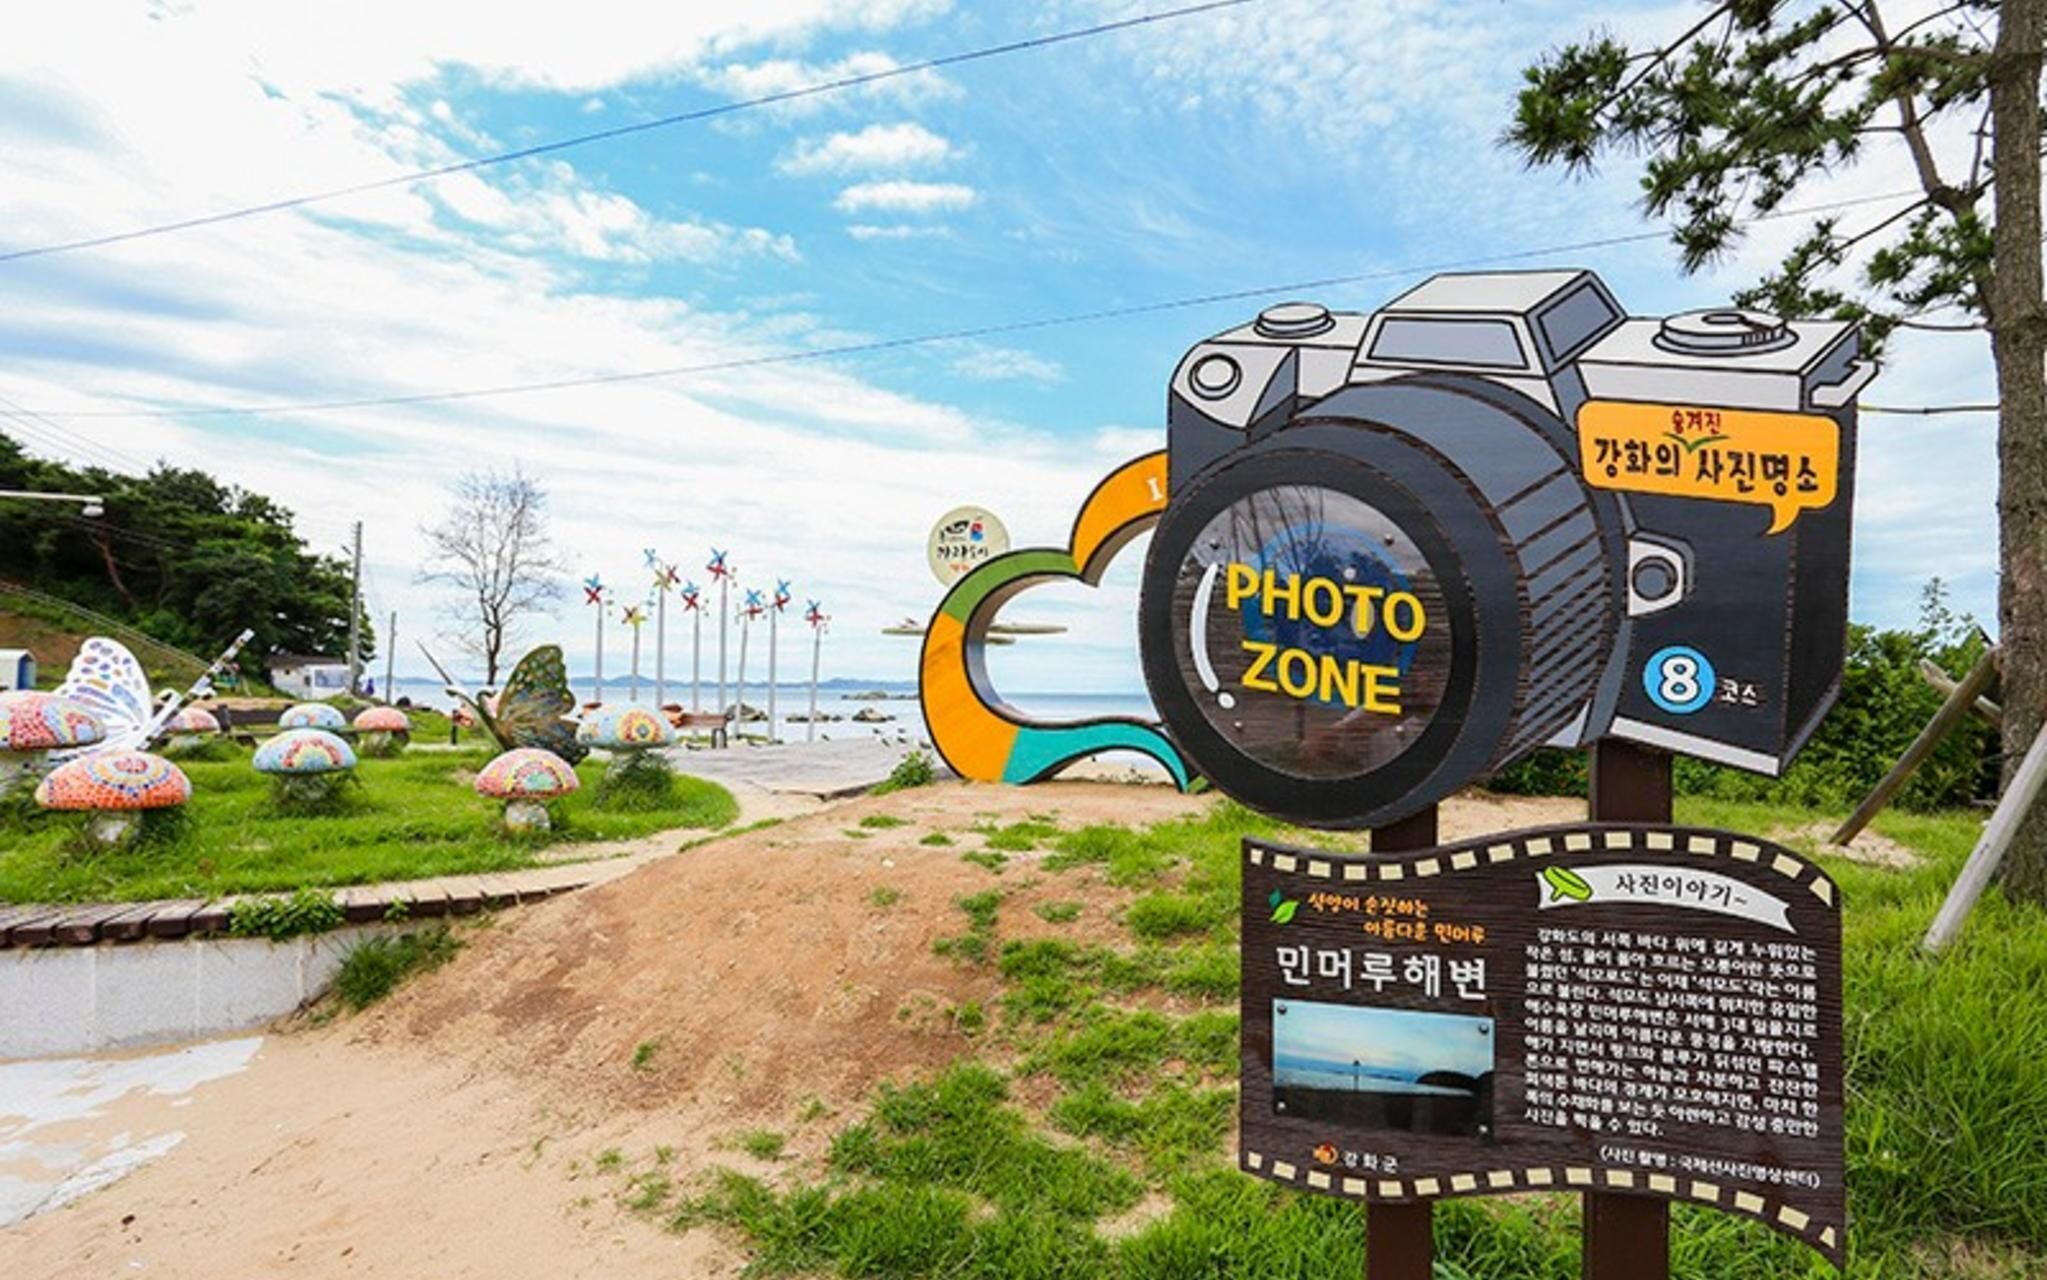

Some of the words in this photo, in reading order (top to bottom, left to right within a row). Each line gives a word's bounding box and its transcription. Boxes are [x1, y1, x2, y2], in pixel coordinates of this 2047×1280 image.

[1671, 410, 1722, 435] 숨겨진
[1595, 437, 1681, 479] 강화의
[1696, 450, 1819, 496] 사진명소
[1226, 562, 1427, 643] PHOTO
[1241, 640, 1402, 715] ZONE
[1660, 655, 1699, 704] 8
[1720, 679, 1759, 706] 코스
[1307, 891, 1360, 914] 석양이
[1363, 894, 1430, 919] 손짓하는
[1363, 920, 1430, 942] 아름다운
[1434, 924, 1488, 944] 민머루
[1538, 928, 1595, 944] 강화도의
[1601, 932, 1631, 948] 서쪽
[1637, 934, 1668, 950] 바다
[1675, 937, 1706, 954] 위에
[1276, 945, 1488, 1000] 민머루해변
[1526, 946, 1553, 962] 작은
[1650, 953, 1696, 972] 흐르는
[1769, 962, 1817, 980] 뜻으로
[1526, 982, 1552, 994] 으로
[1608, 988, 1652, 1004] 석모도
[1720, 998, 1765, 1014] 위치한
[1770, 1002, 1817, 1020] 유일한
[1784, 983, 1816, 1000] 이름
[1525, 999, 1584, 1017] 해수욕장
[1588, 1005, 1678, 1026] 민머루해변은
[1684, 1013, 1715, 1030] 서해
[1722, 1018, 1747, 1033] 3대
[1524, 1036, 1553, 1052] 해가
[1560, 1038, 1604, 1056] 지면서
[1610, 1043, 1654, 1061] 핑크와
[1662, 1048, 1708, 1066] 블루가
[1768, 1059, 1818, 1078] 파스텔
[1525, 1018, 1568, 1034] 이름을
[1622, 1026, 1682, 1045] 아름다운
[1690, 1032, 1736, 1051] 풍경을
[1742, 1036, 1814, 1058] 자랑한다.
[1526, 1053, 1568, 1069] 톤으로
[1576, 1058, 1636, 1078] 변해가는
[1642, 1065, 1688, 1082] 하늘과
[1696, 1070, 1760, 1090] 차분하고
[1768, 1078, 1818, 1098] 잔잔한
[1558, 1094, 1612, 1112] 수채화를
[1618, 1100, 1646, 1117] 보는
[1668, 1106, 1731, 1125] 아련하고
[1736, 1112, 1766, 1130] 감성
[1573, 1076, 1618, 1094] 바다의
[1623, 1082, 1668, 1100] 경계가
[1763, 1096, 1796, 1114] 마치
[1802, 1102, 1818, 1117] 한
[1525, 1108, 1567, 1126] 사진을
[1574, 1113, 1602, 1130] 찍을
[1608, 1118, 1622, 1132] 수
[1627, 1119, 1664, 1136] 있다.
